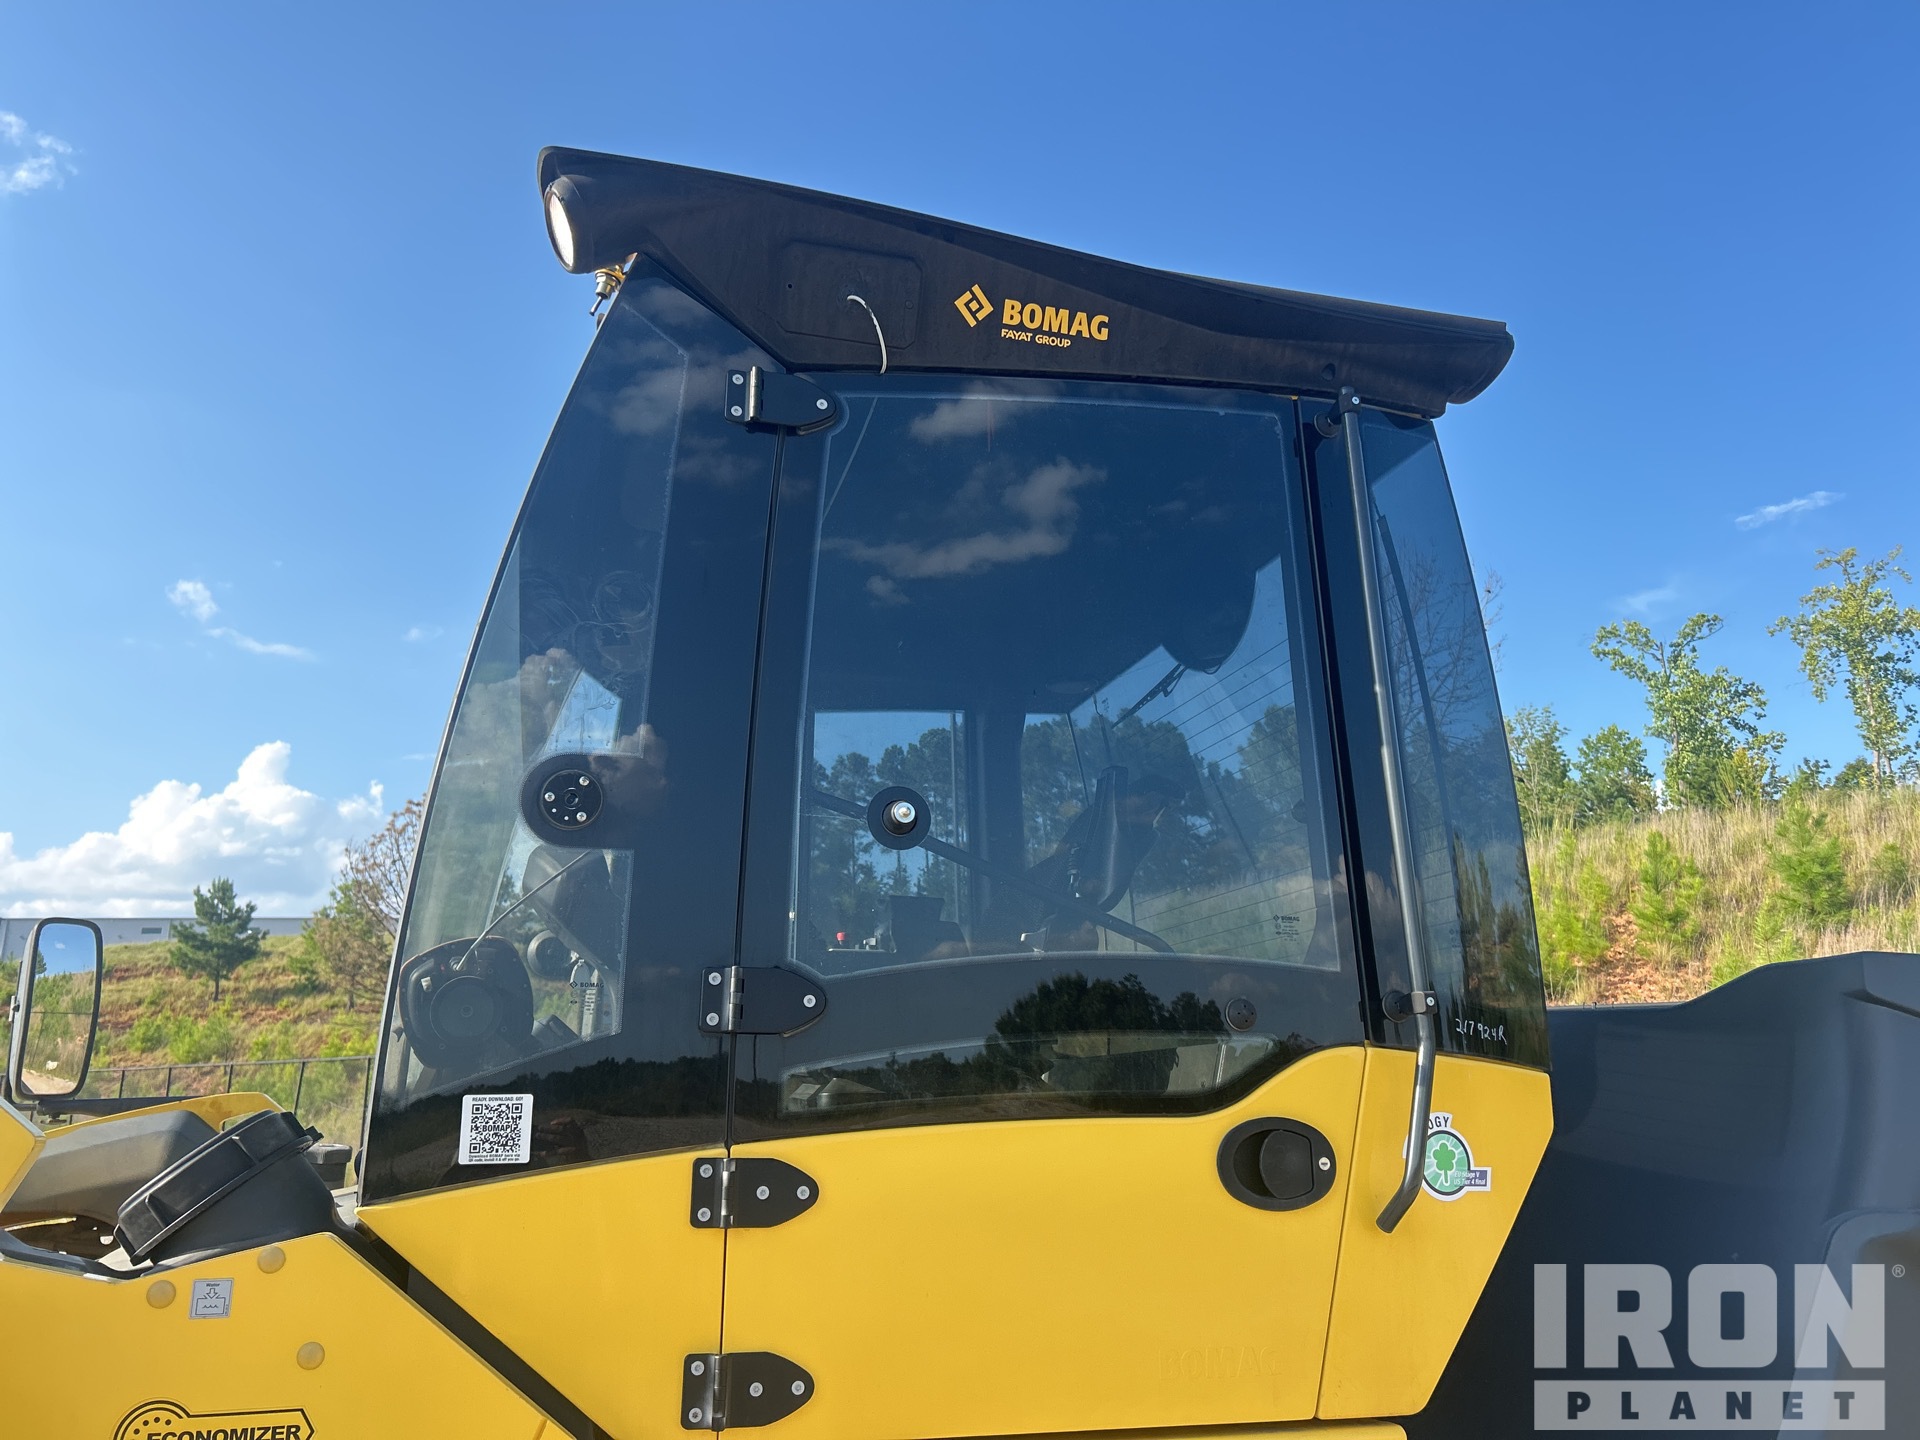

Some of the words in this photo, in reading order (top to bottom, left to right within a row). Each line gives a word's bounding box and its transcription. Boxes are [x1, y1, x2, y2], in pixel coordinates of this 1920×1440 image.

[1002, 299, 1110, 341] BOMAG
[1001, 329, 1033, 342] FAYAT
[1035, 334, 1071, 348] GROUP
[482, 1124, 511, 1132] BOMAP
[1462, 1171, 1475, 1179] Stage
